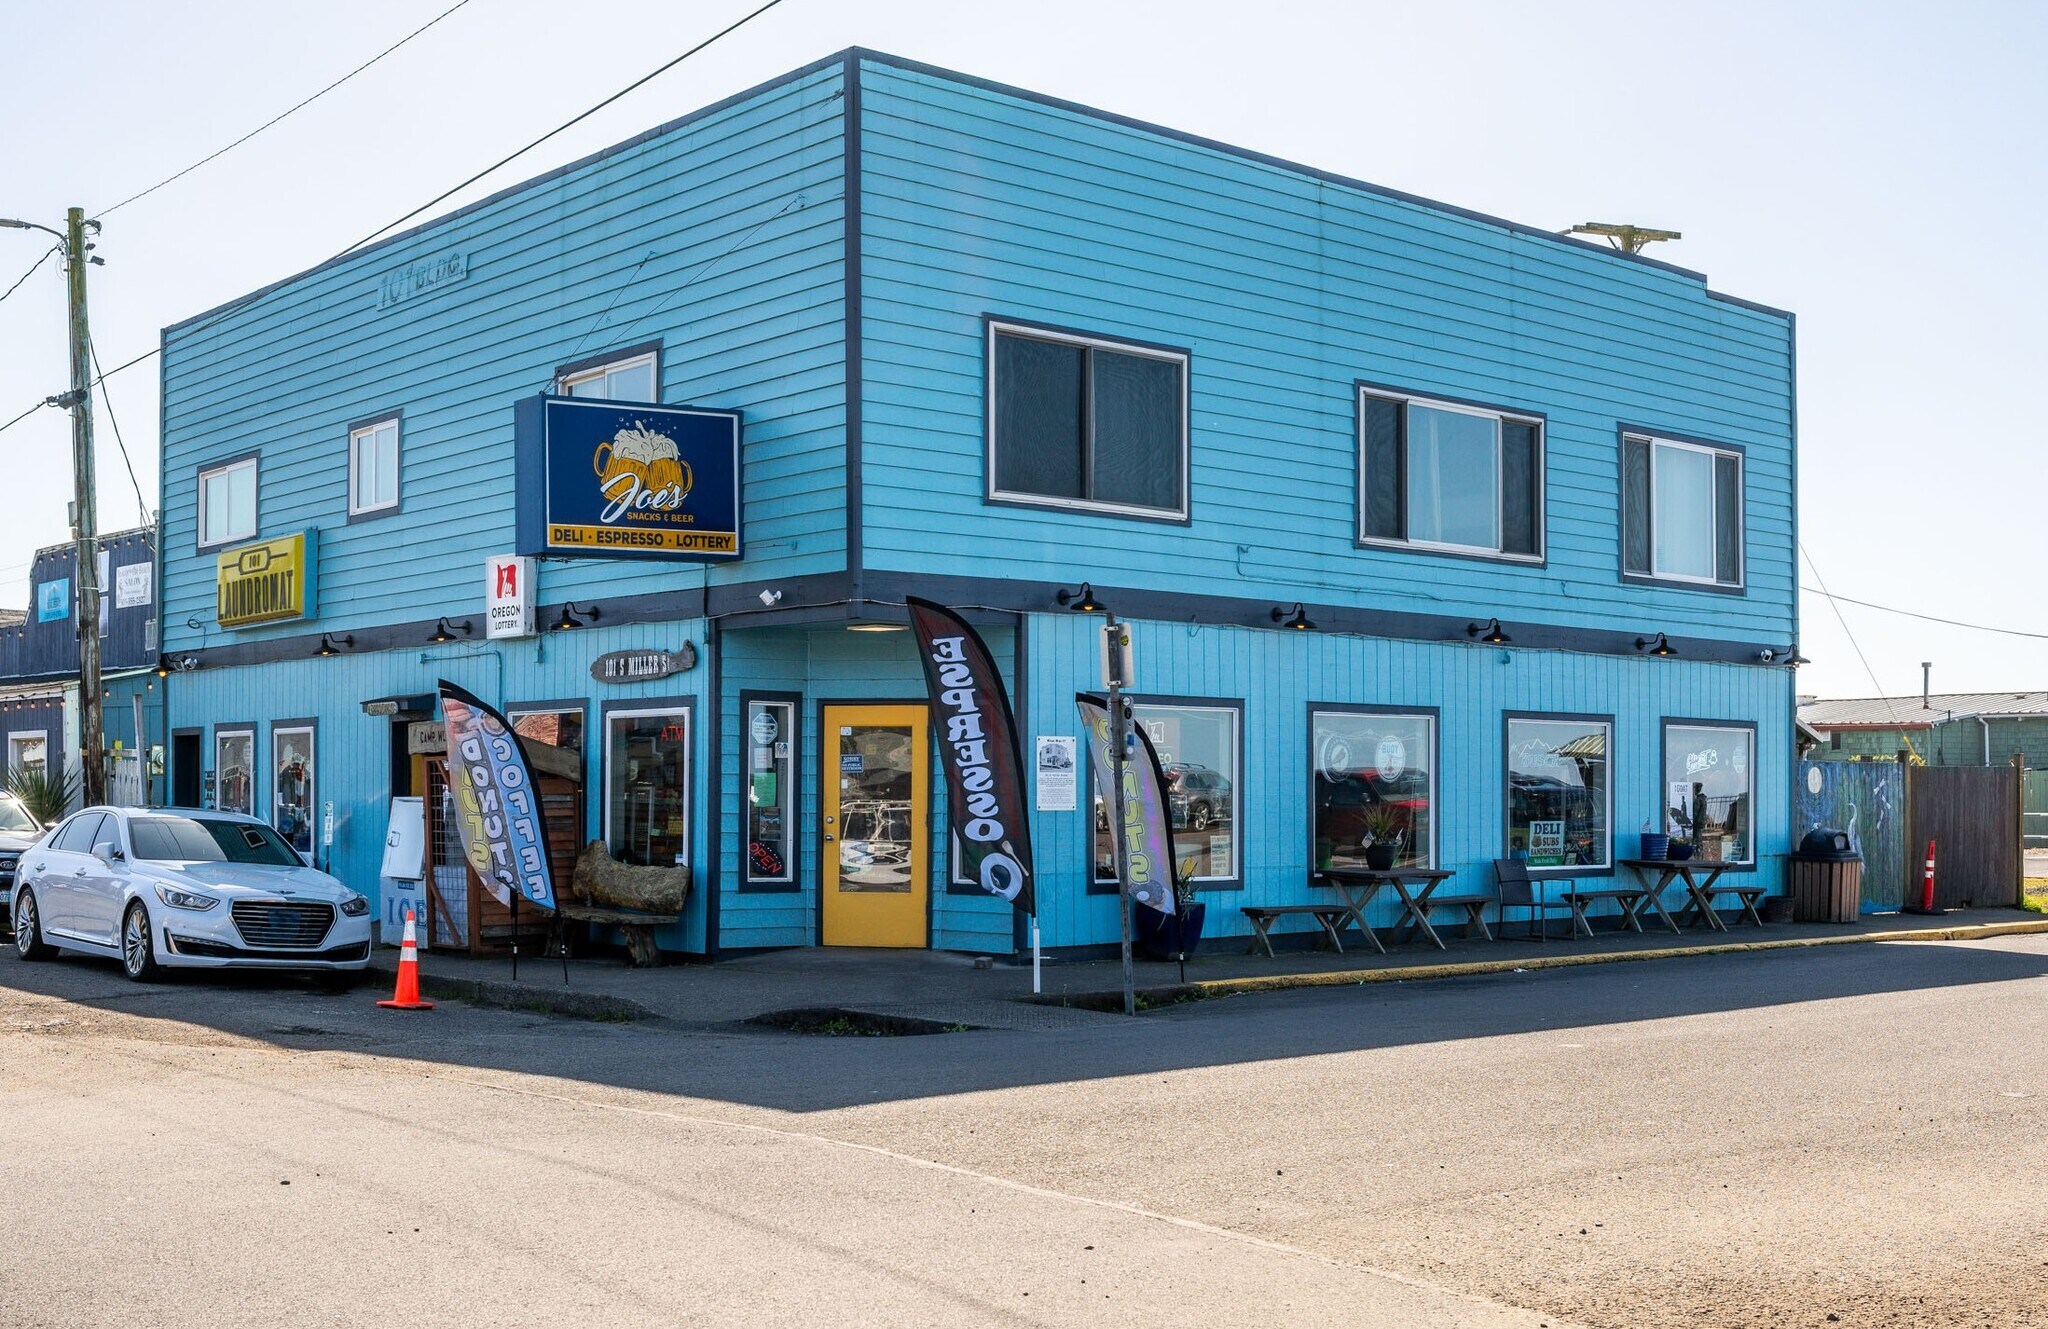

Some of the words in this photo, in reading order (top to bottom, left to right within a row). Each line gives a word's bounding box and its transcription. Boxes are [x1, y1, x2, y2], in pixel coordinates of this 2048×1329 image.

[600, 473, 687, 524] Joe's
[626, 512, 661, 522] SNACKS
[671, 513, 694, 523] BEER
[554, 529, 583, 542] DELI
[596, 531, 664, 546] ESPRESSO
[676, 534, 731, 548] LOTTERY
[249, 554, 260, 568] 101
[218, 570, 293, 620] LAUNDROMAT
[492, 605, 520, 619] OREGON
[495, 620, 518, 631] LOTTERY
[605, 659, 616, 677] 101
[620, 659, 625, 676] S
[628, 655, 659, 676] MILLER
[661, 724, 683, 741] ATM
[1534, 823, 1561, 835] DELI
[1542, 836, 1560, 847] SUBS
[750, 842, 783, 874] OPEN
[1530, 848, 1562, 856] SANDWICHES
[388, 896, 427, 927] ICE
